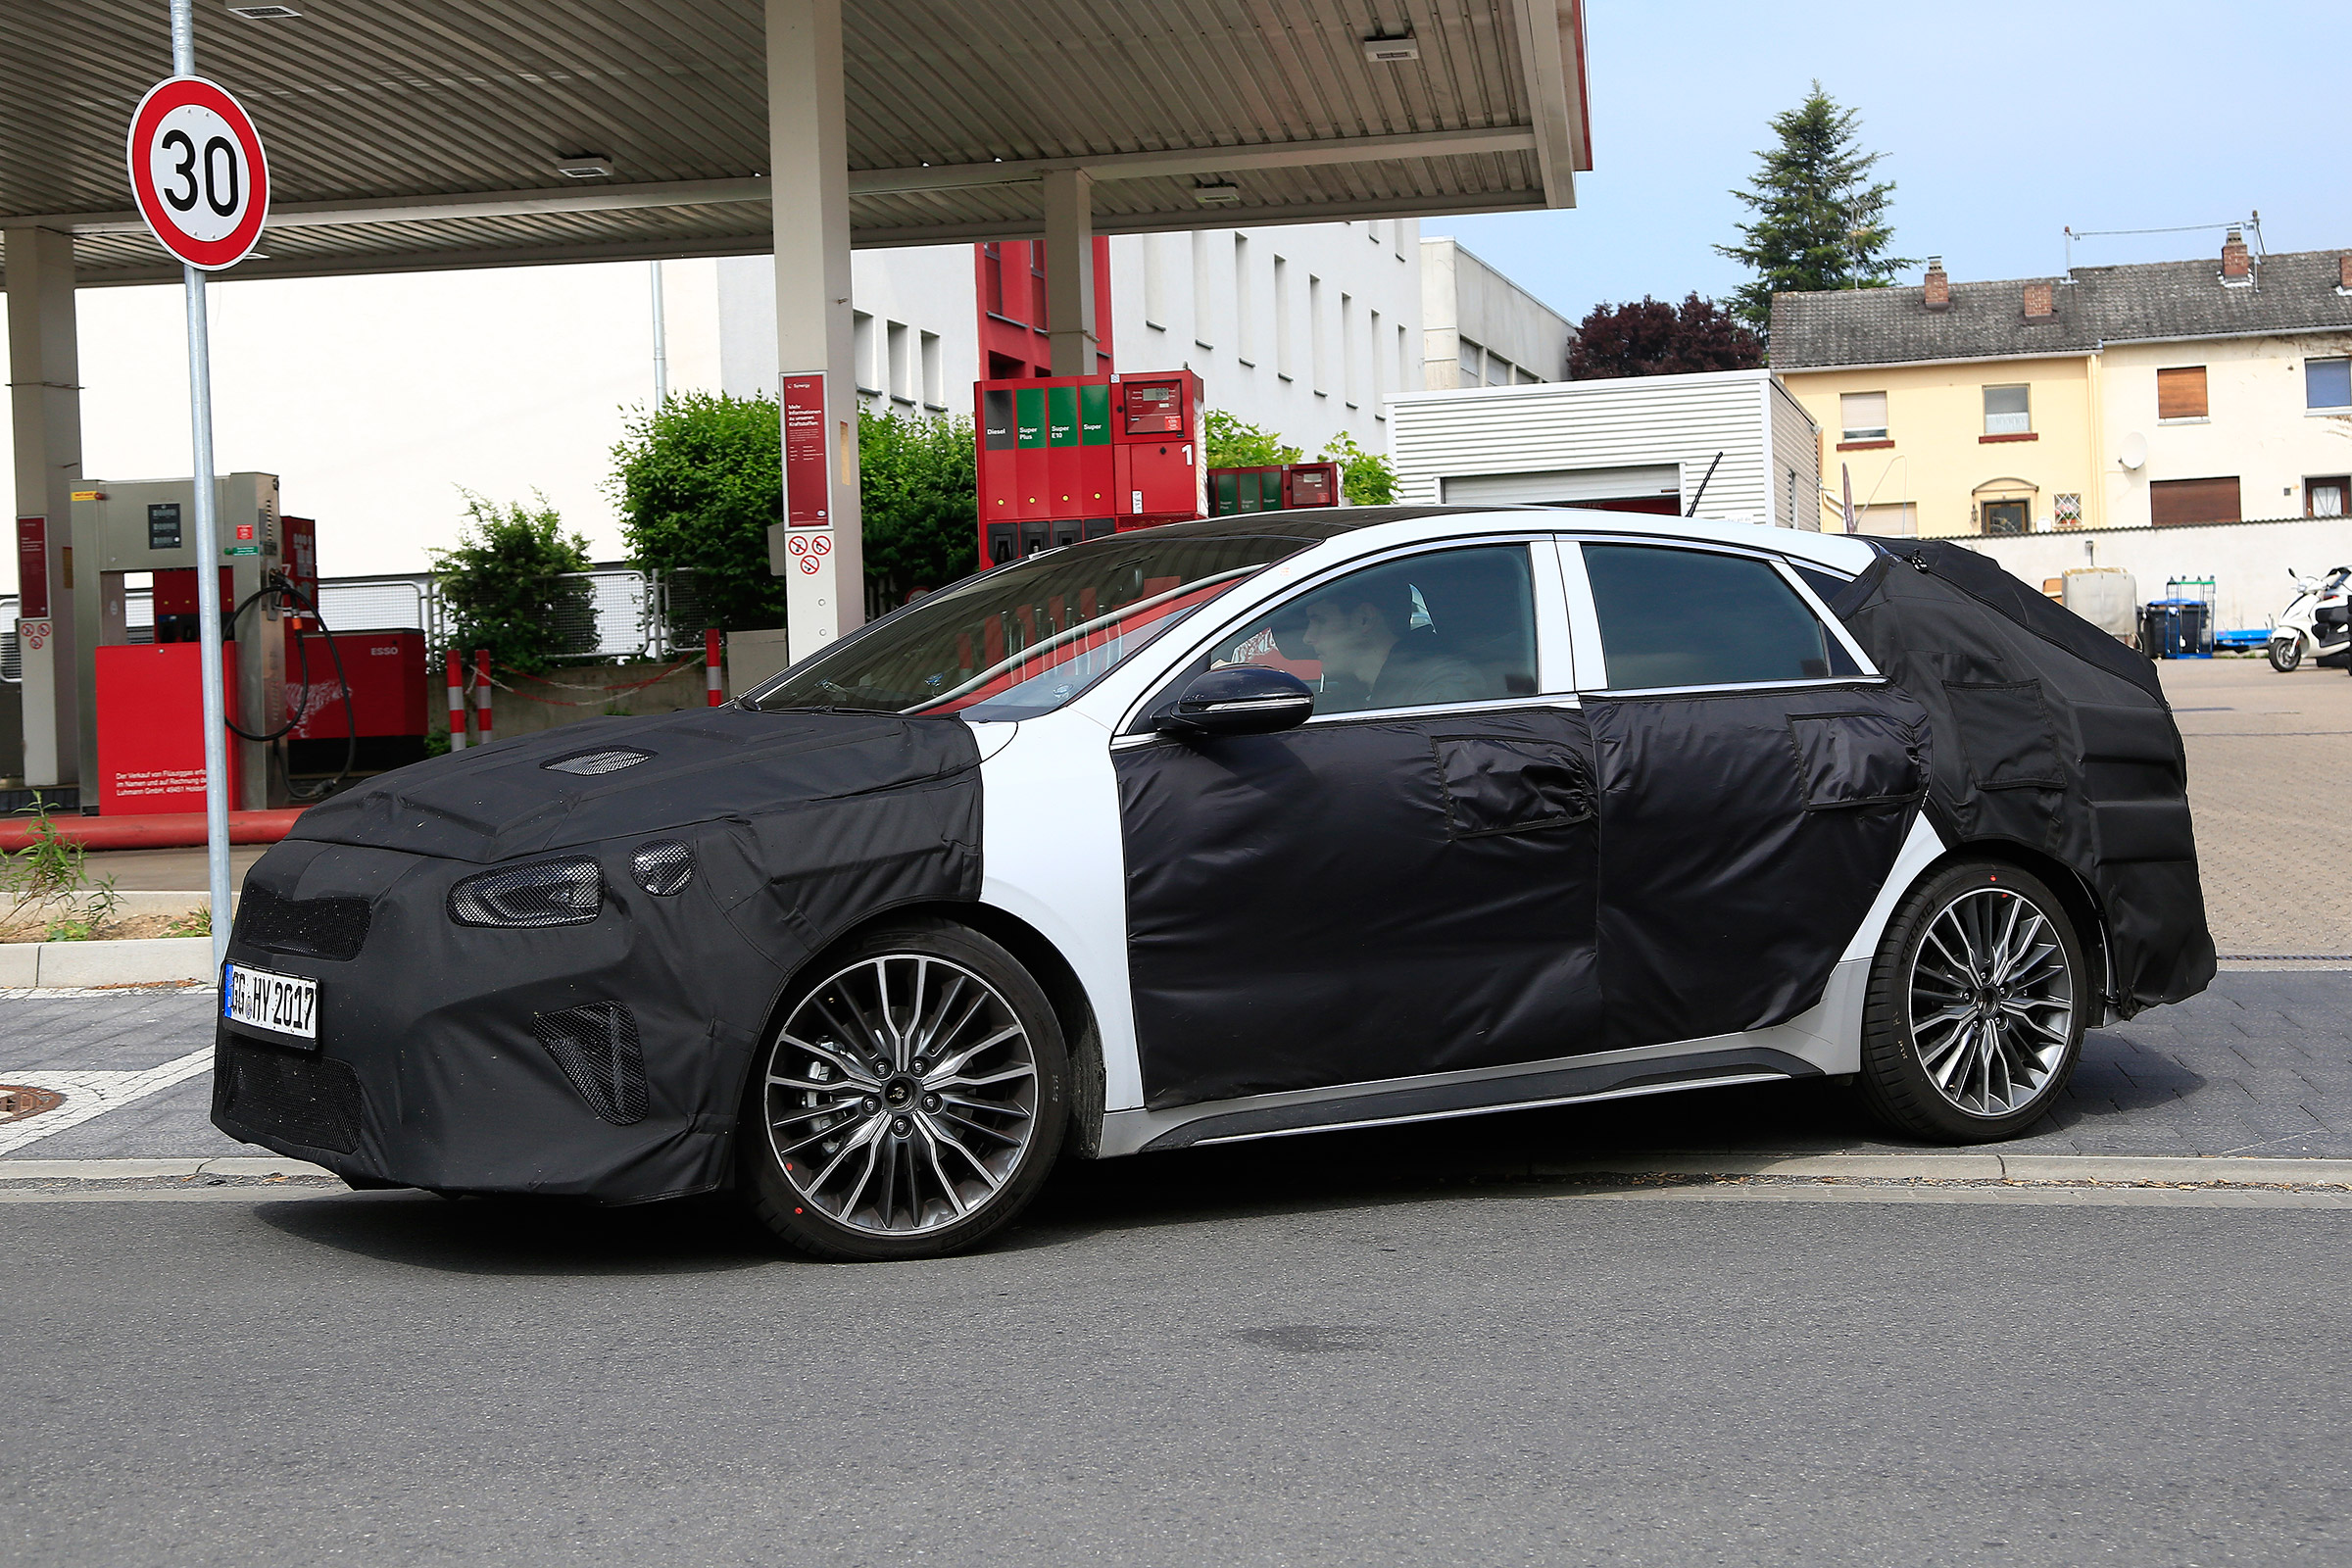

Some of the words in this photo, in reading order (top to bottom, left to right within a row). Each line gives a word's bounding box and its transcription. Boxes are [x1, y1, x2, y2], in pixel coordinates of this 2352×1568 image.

[162, 129, 238, 217] 30
[1181, 444, 1193, 466] 1
[253, 977, 270, 1022] HY
[273, 982, 315, 1031] 2017
